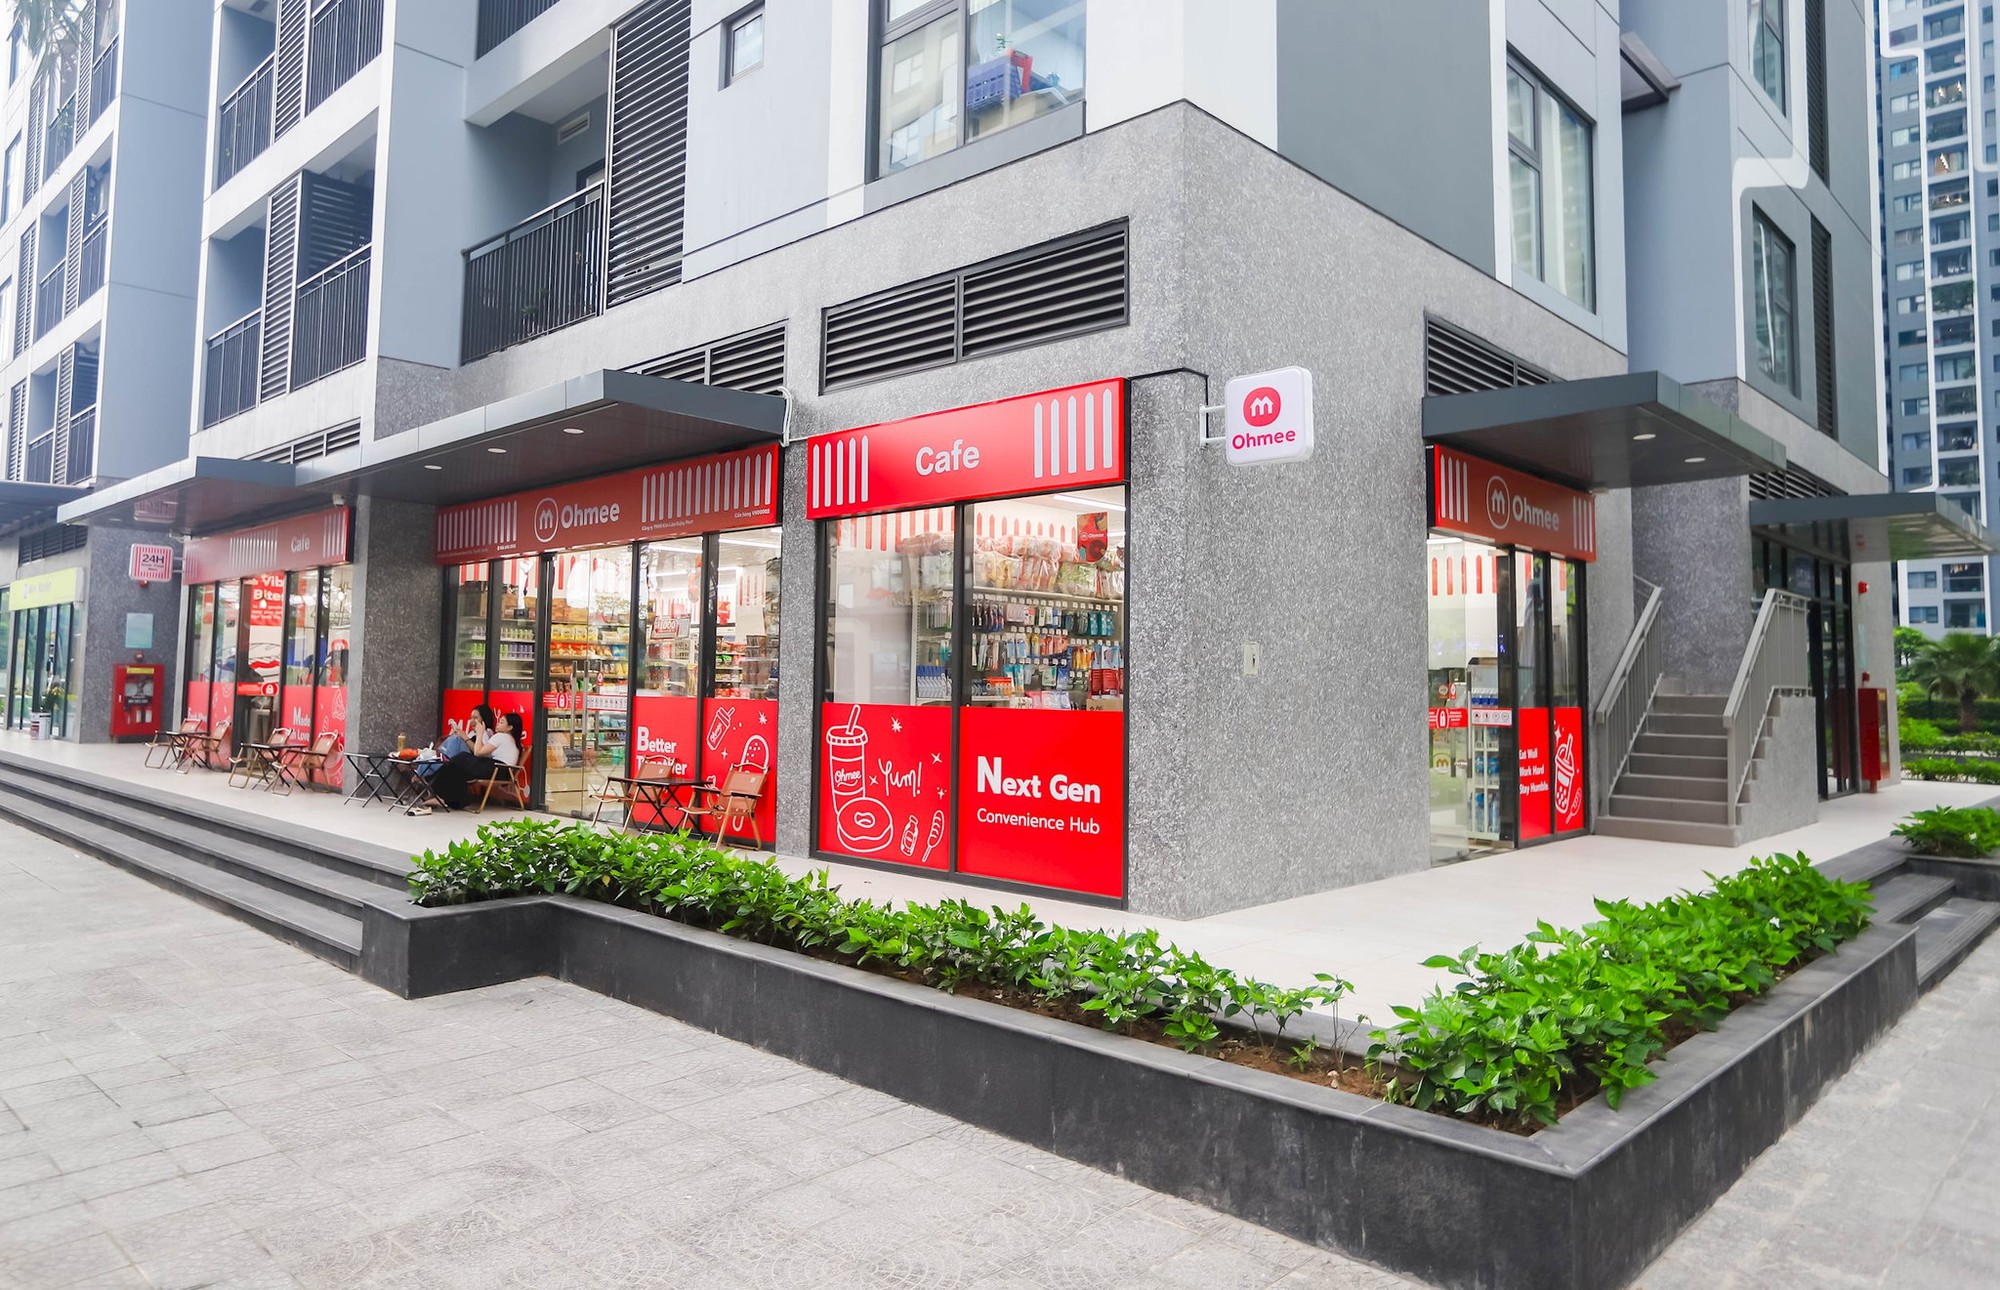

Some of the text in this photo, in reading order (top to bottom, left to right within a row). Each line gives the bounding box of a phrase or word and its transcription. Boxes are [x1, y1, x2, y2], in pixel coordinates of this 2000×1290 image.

[1232, 430, 1296, 450] Ohmee
[915, 439, 980, 476] Cafe
[561, 503, 620, 529] Ohmee
[1512, 495, 1559, 531] Ohmee
[291, 533, 310, 553] Cafe
[142, 553, 165, 564] 24H
[637, 726, 677, 753] Better
[835, 768, 862, 782] Ohmee
[878, 758, 922, 797] Yum!
[977, 755, 1100, 804] Next Gen
[977, 808, 1100, 835] Convenience Hub
